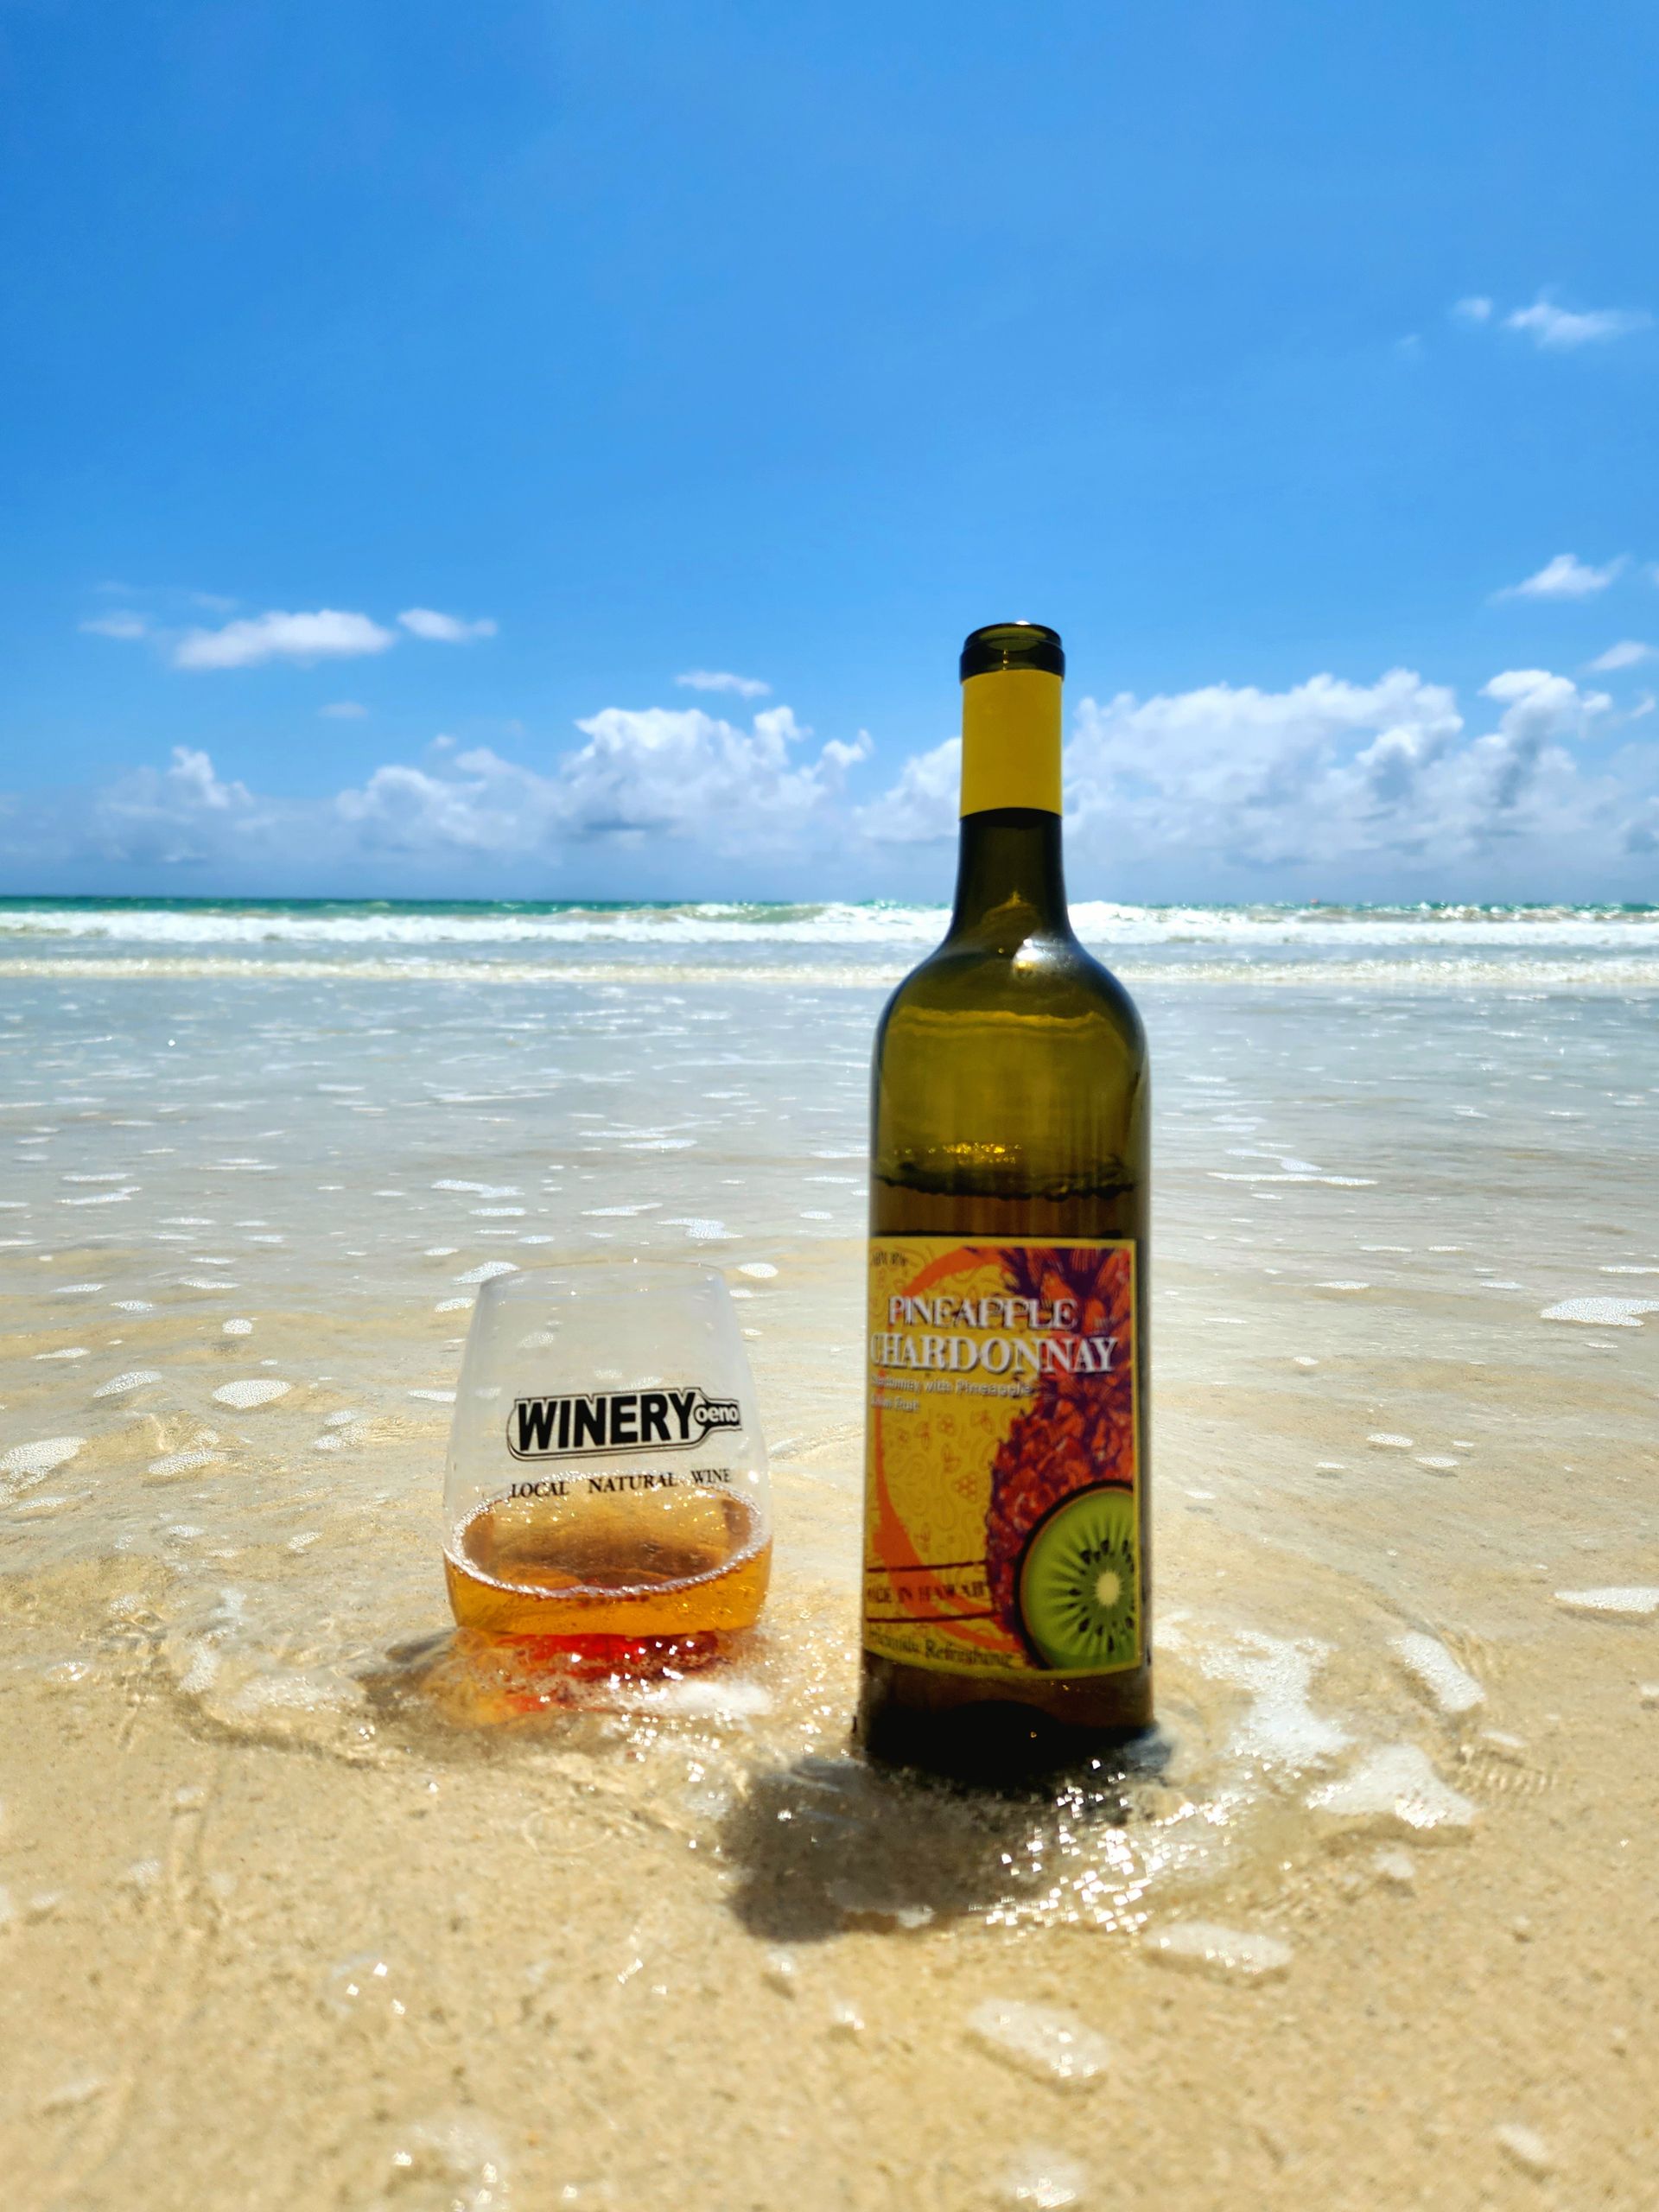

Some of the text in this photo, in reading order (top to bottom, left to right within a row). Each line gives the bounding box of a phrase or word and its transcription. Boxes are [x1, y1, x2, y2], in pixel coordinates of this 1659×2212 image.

[888, 1296, 1077, 1331] PINEAPPLE
[871, 1332, 1118, 1374] CHARDONNAY
[956, 1379, 1034, 1397] Pineapple
[518, 1391, 739, 1452] WINERY oeno
[512, 1469, 731, 1498] LOCAL NATURAL WINE
